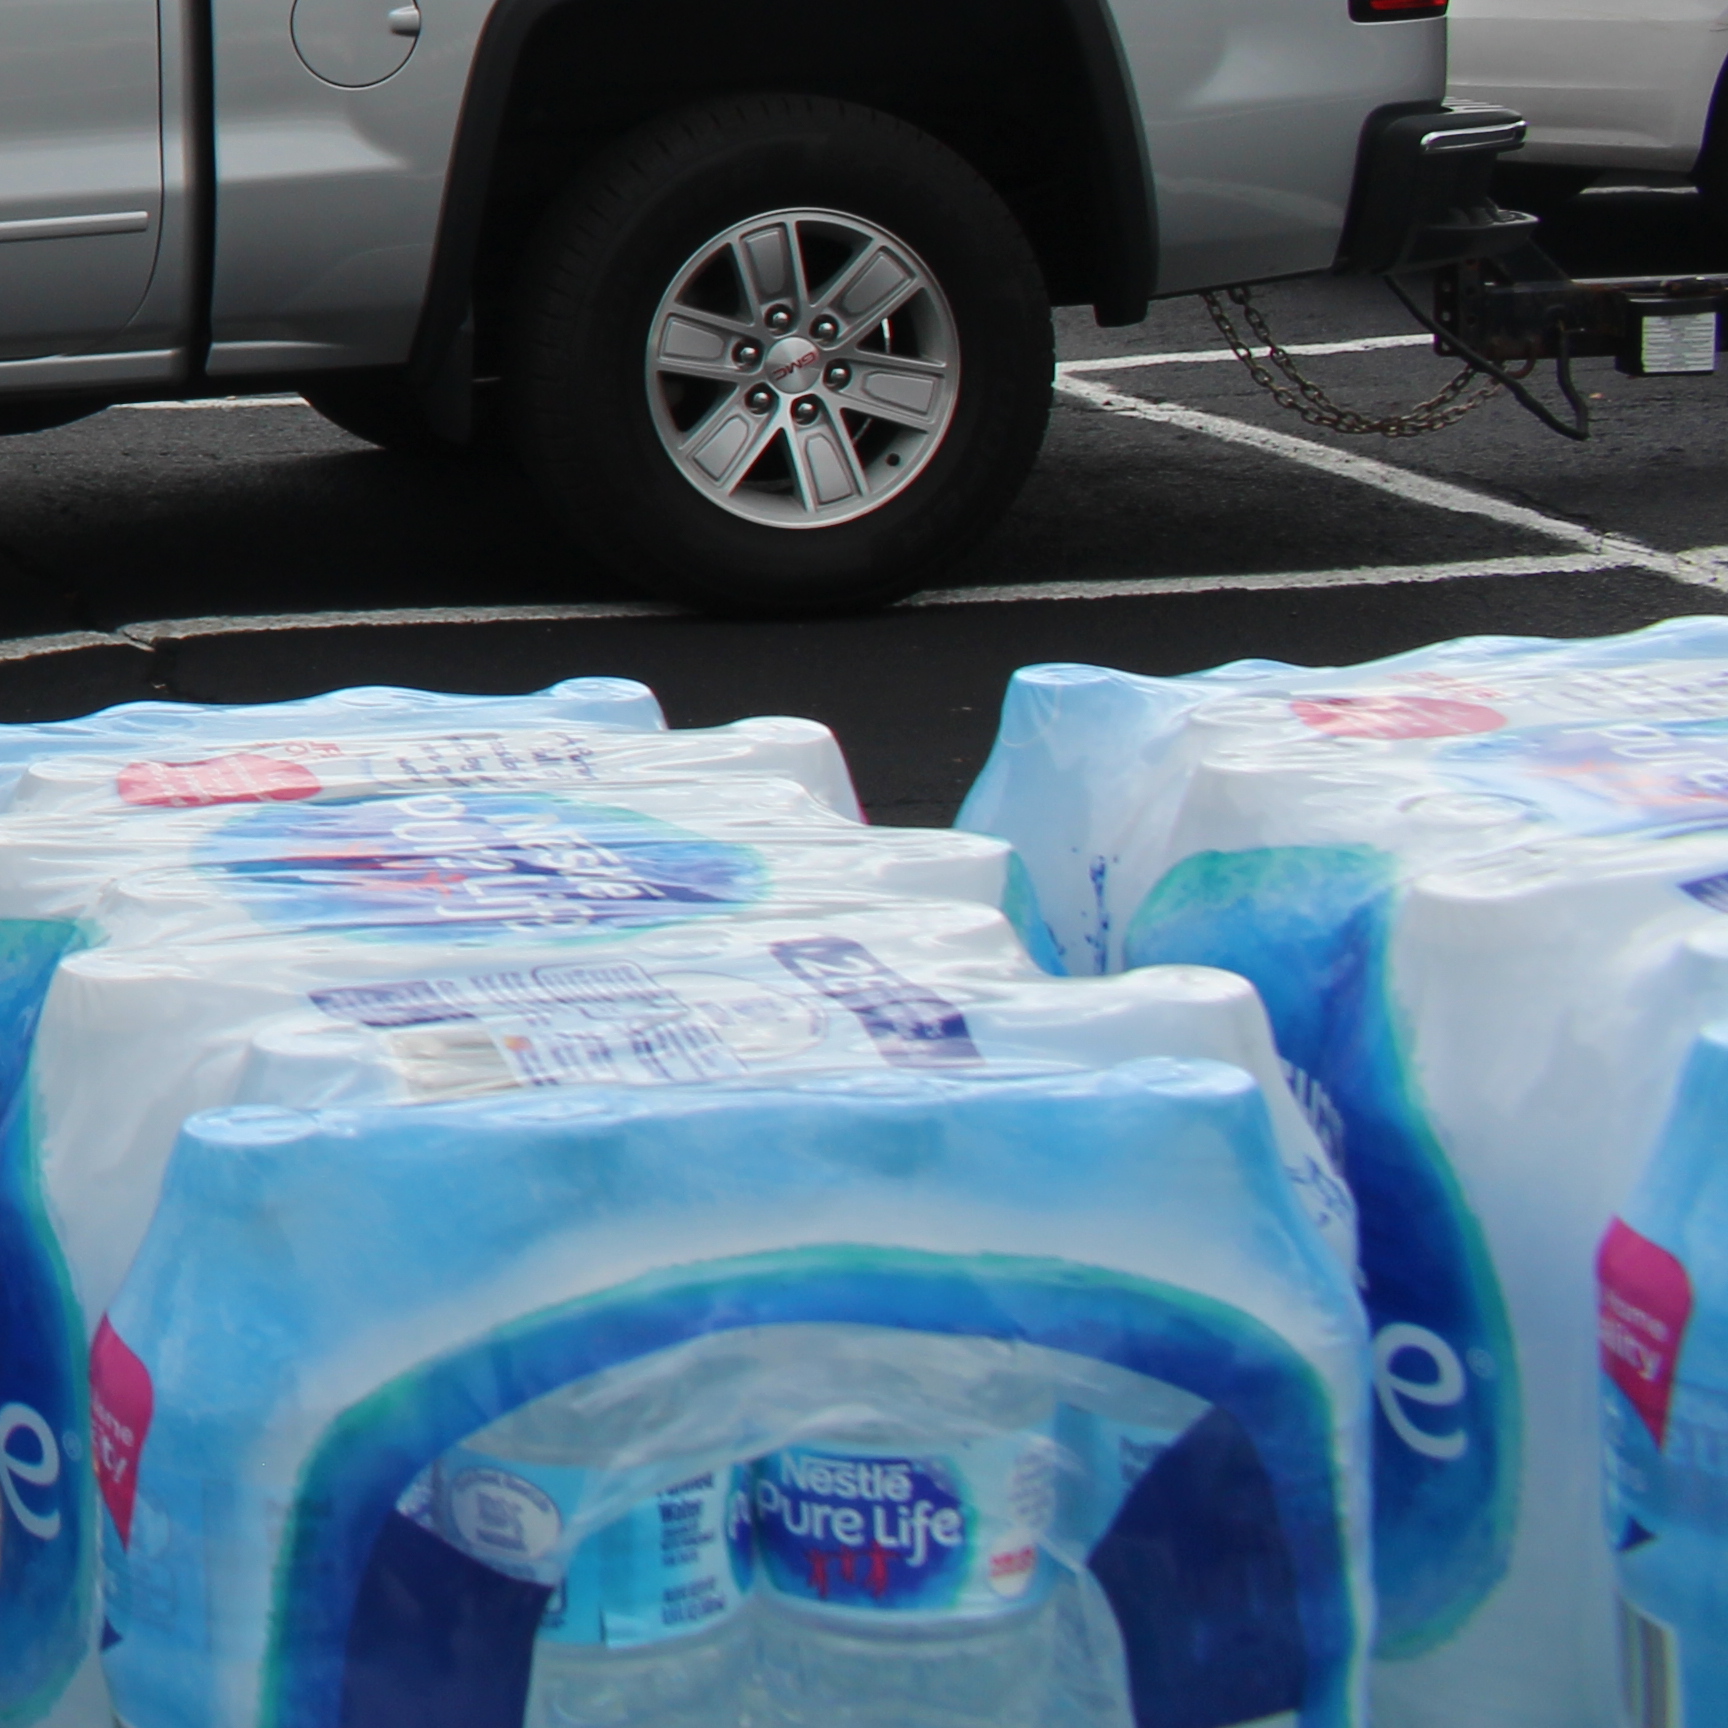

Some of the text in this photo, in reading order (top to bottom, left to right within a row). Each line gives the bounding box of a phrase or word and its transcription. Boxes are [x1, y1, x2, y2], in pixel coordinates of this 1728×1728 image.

[772, 350, 818, 381] GMC
[780, 1454, 913, 1502] Nestlé
[756, 1477, 866, 1547] Pure
[873, 1500, 964, 1568] Life
